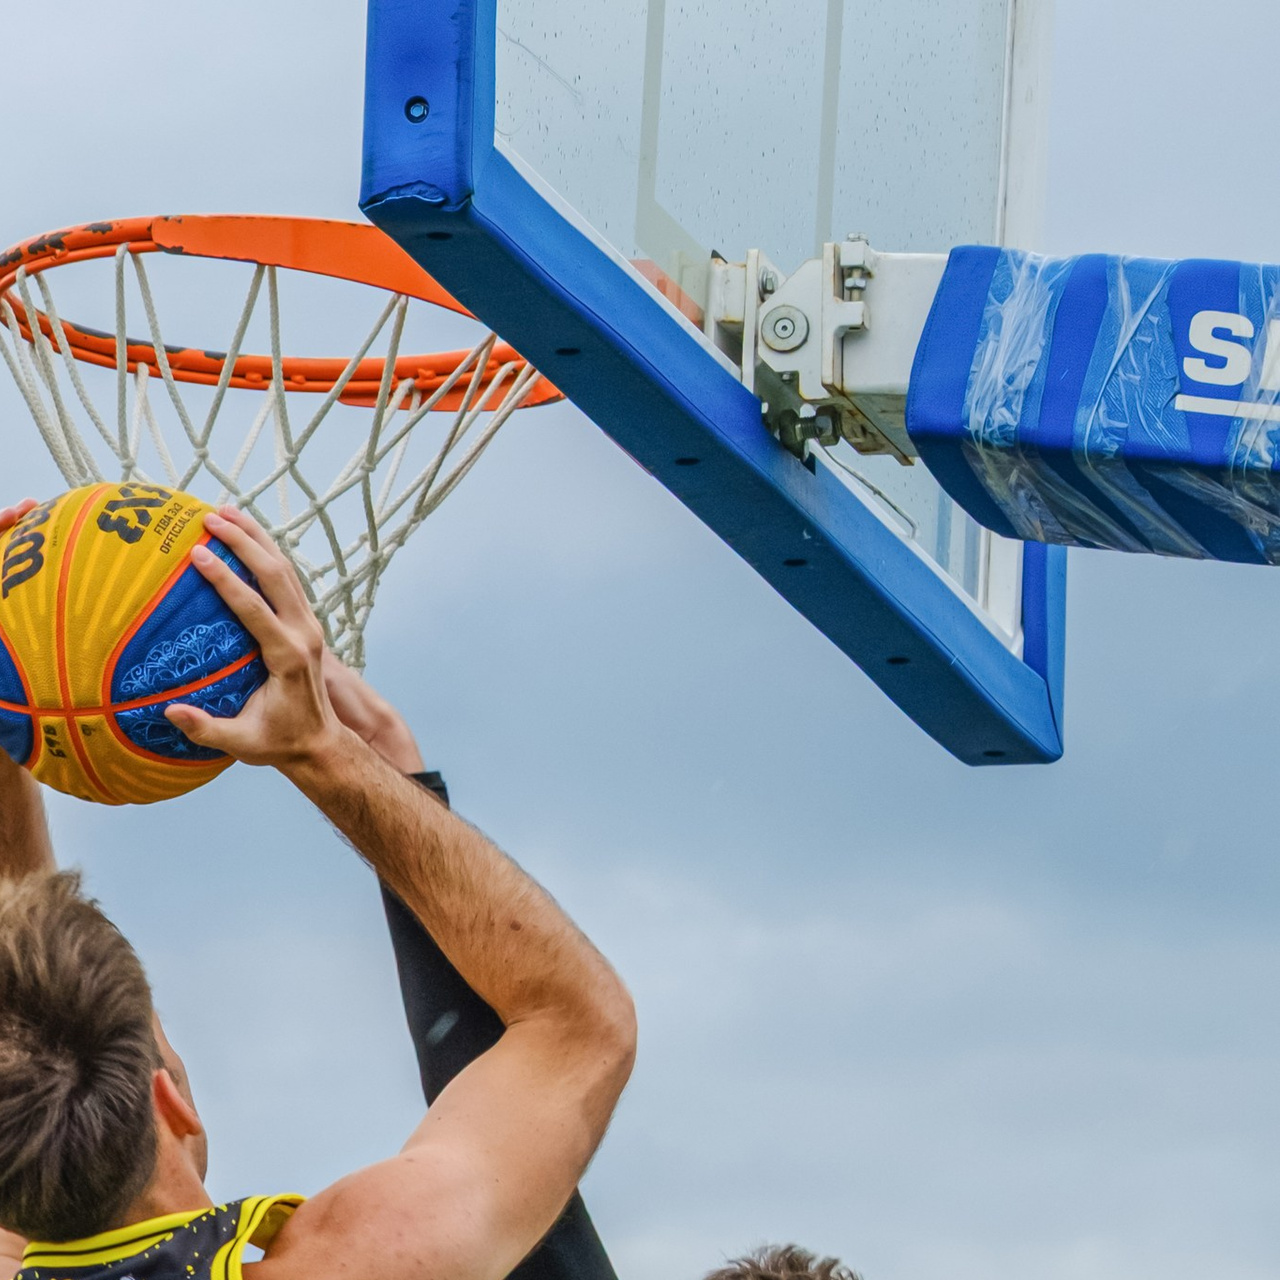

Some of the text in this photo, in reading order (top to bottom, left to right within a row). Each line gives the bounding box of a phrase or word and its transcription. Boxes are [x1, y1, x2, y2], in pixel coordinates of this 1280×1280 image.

[1183, 310, 1280, 390] S
[153, 514, 173, 536] FIBA
[159, 517, 189, 554] OFFICIAL
